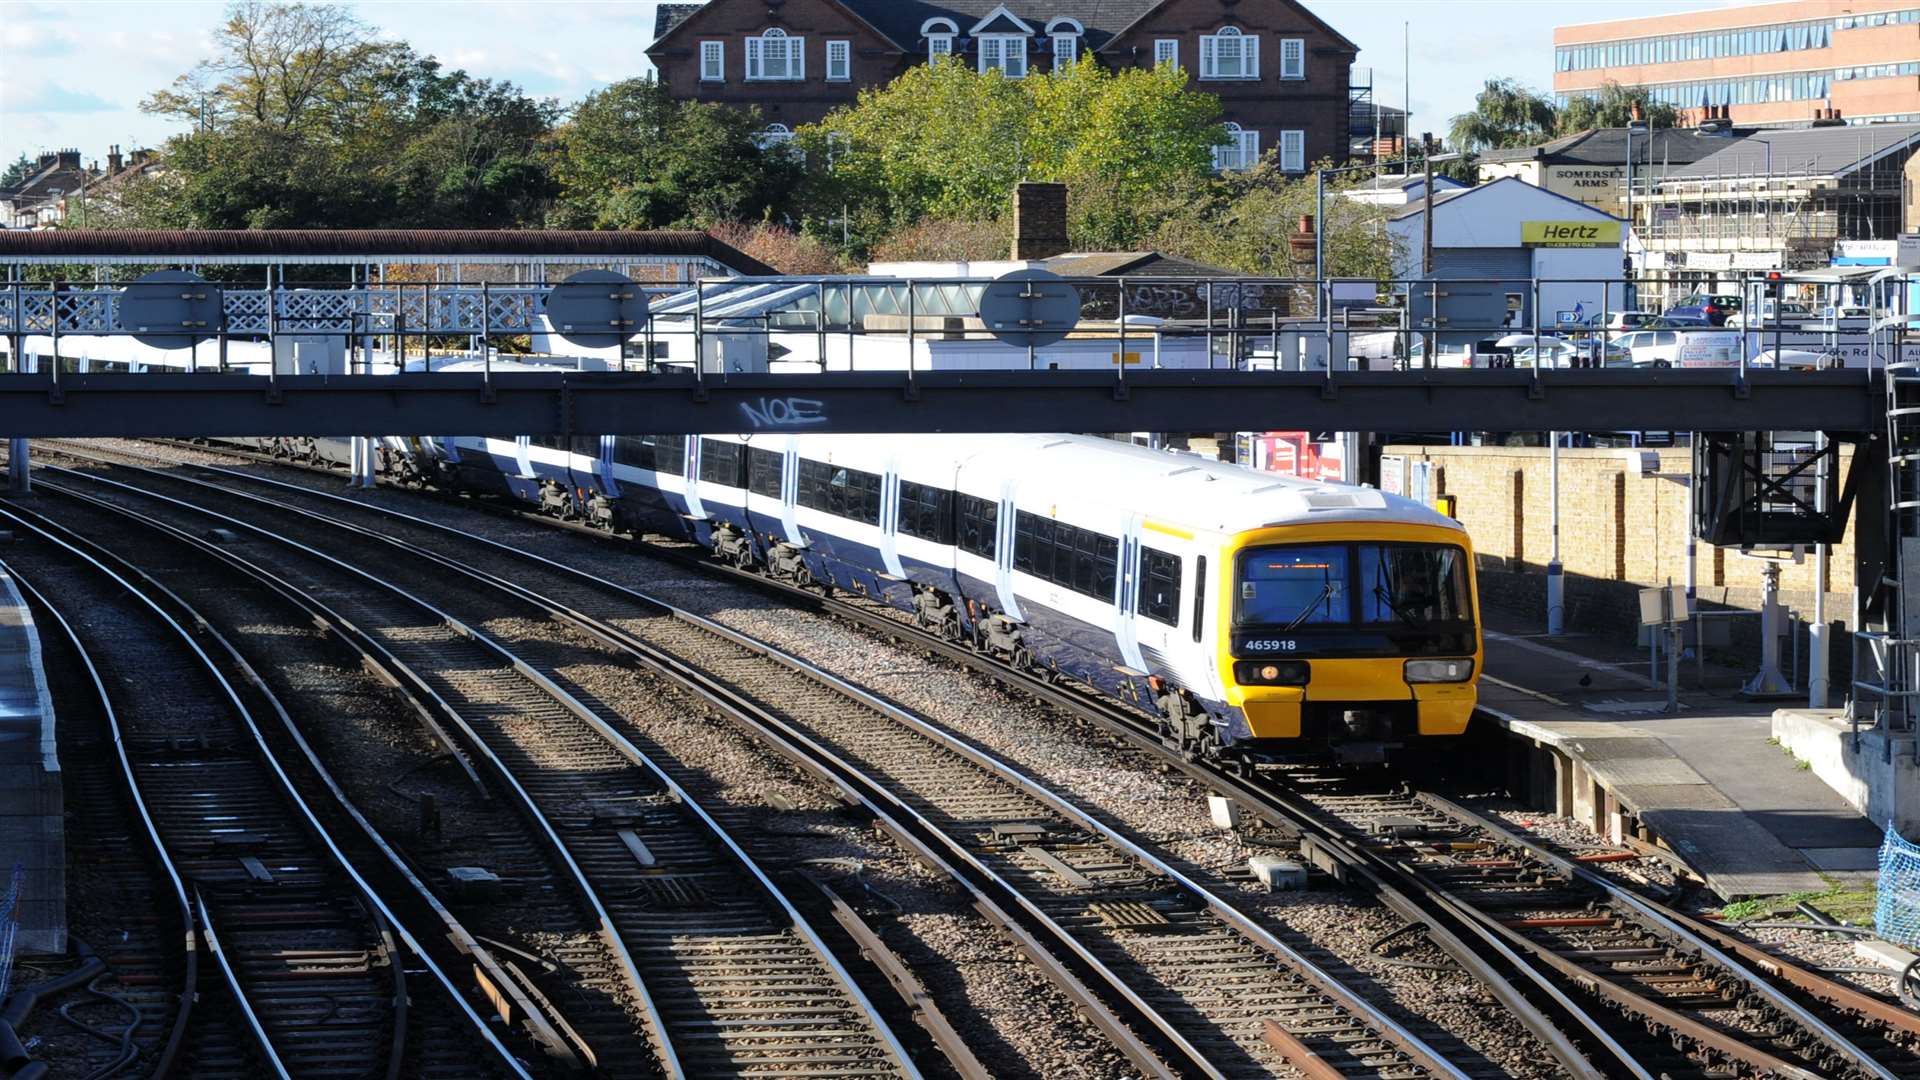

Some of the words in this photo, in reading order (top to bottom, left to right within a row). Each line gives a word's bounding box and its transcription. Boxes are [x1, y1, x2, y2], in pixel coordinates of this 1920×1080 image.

[1556, 170, 1624, 179] SOMERSET
[1543, 225, 1599, 239] Hertz
[1852, 348, 1869, 357] Rd
[740, 397, 828, 427] NOE
[1245, 640, 1296, 650] 465918
